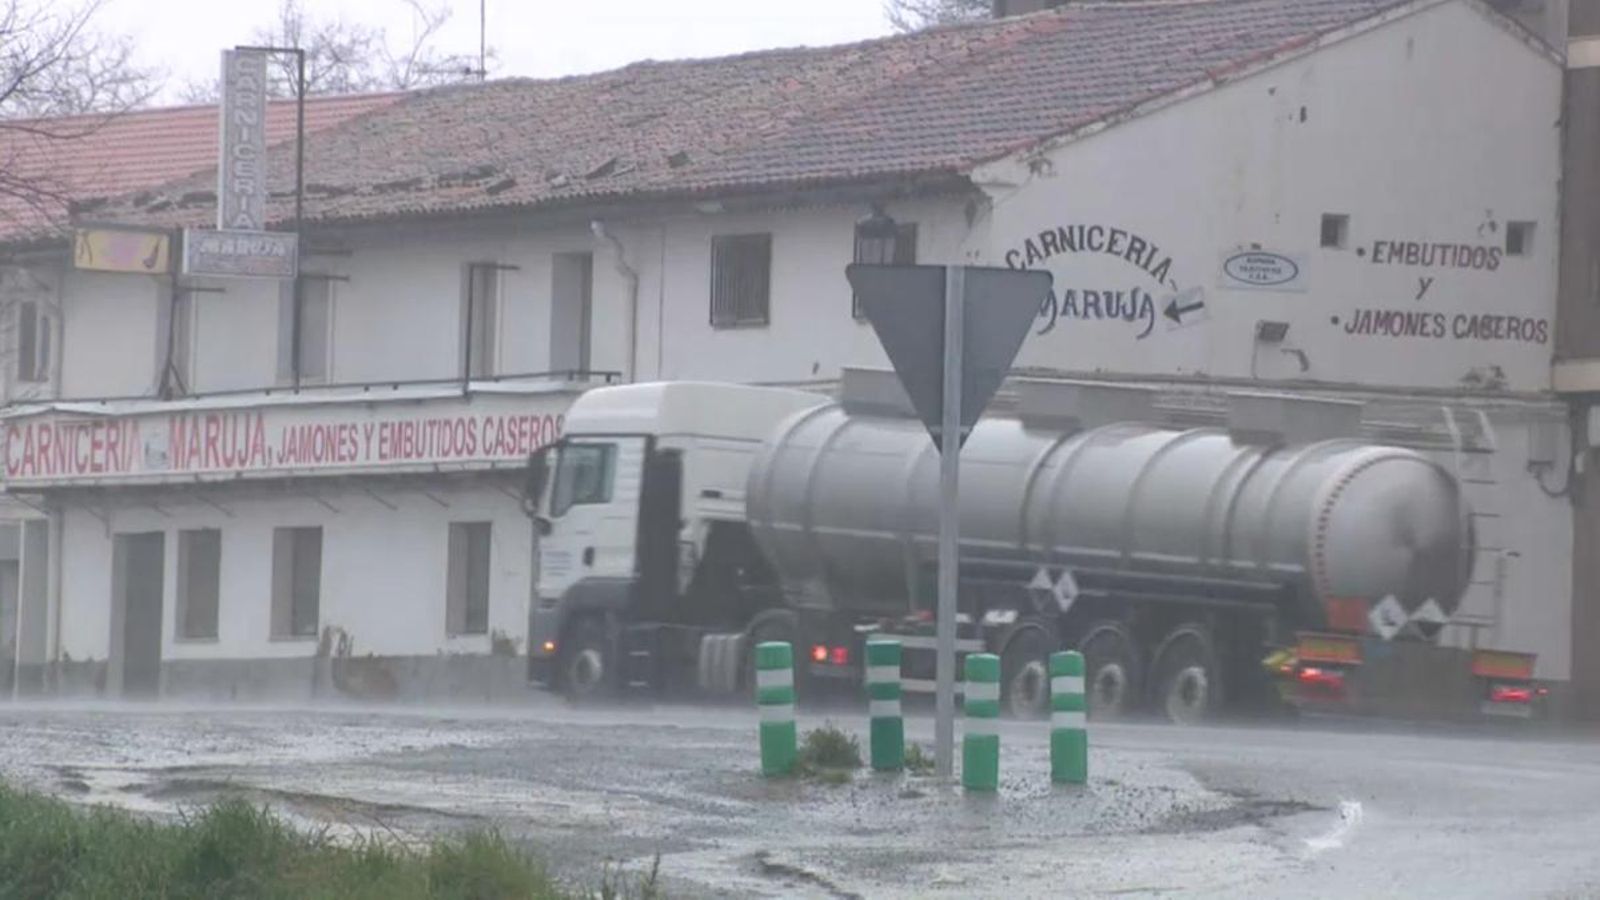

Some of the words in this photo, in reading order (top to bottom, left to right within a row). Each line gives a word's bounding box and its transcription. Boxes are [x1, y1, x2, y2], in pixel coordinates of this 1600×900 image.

[1005, 225, 1173, 285] CARNICERIA
[1371, 241, 1503, 271] EMBUTIDOS
[1344, 308, 1447, 340] JAMONES
[6, 419, 141, 476] CARNICERIA
[276, 421, 359, 464] JAMONES
[363, 422, 375, 461] Y
[378, 416, 477, 461] EMBUTIDOS
